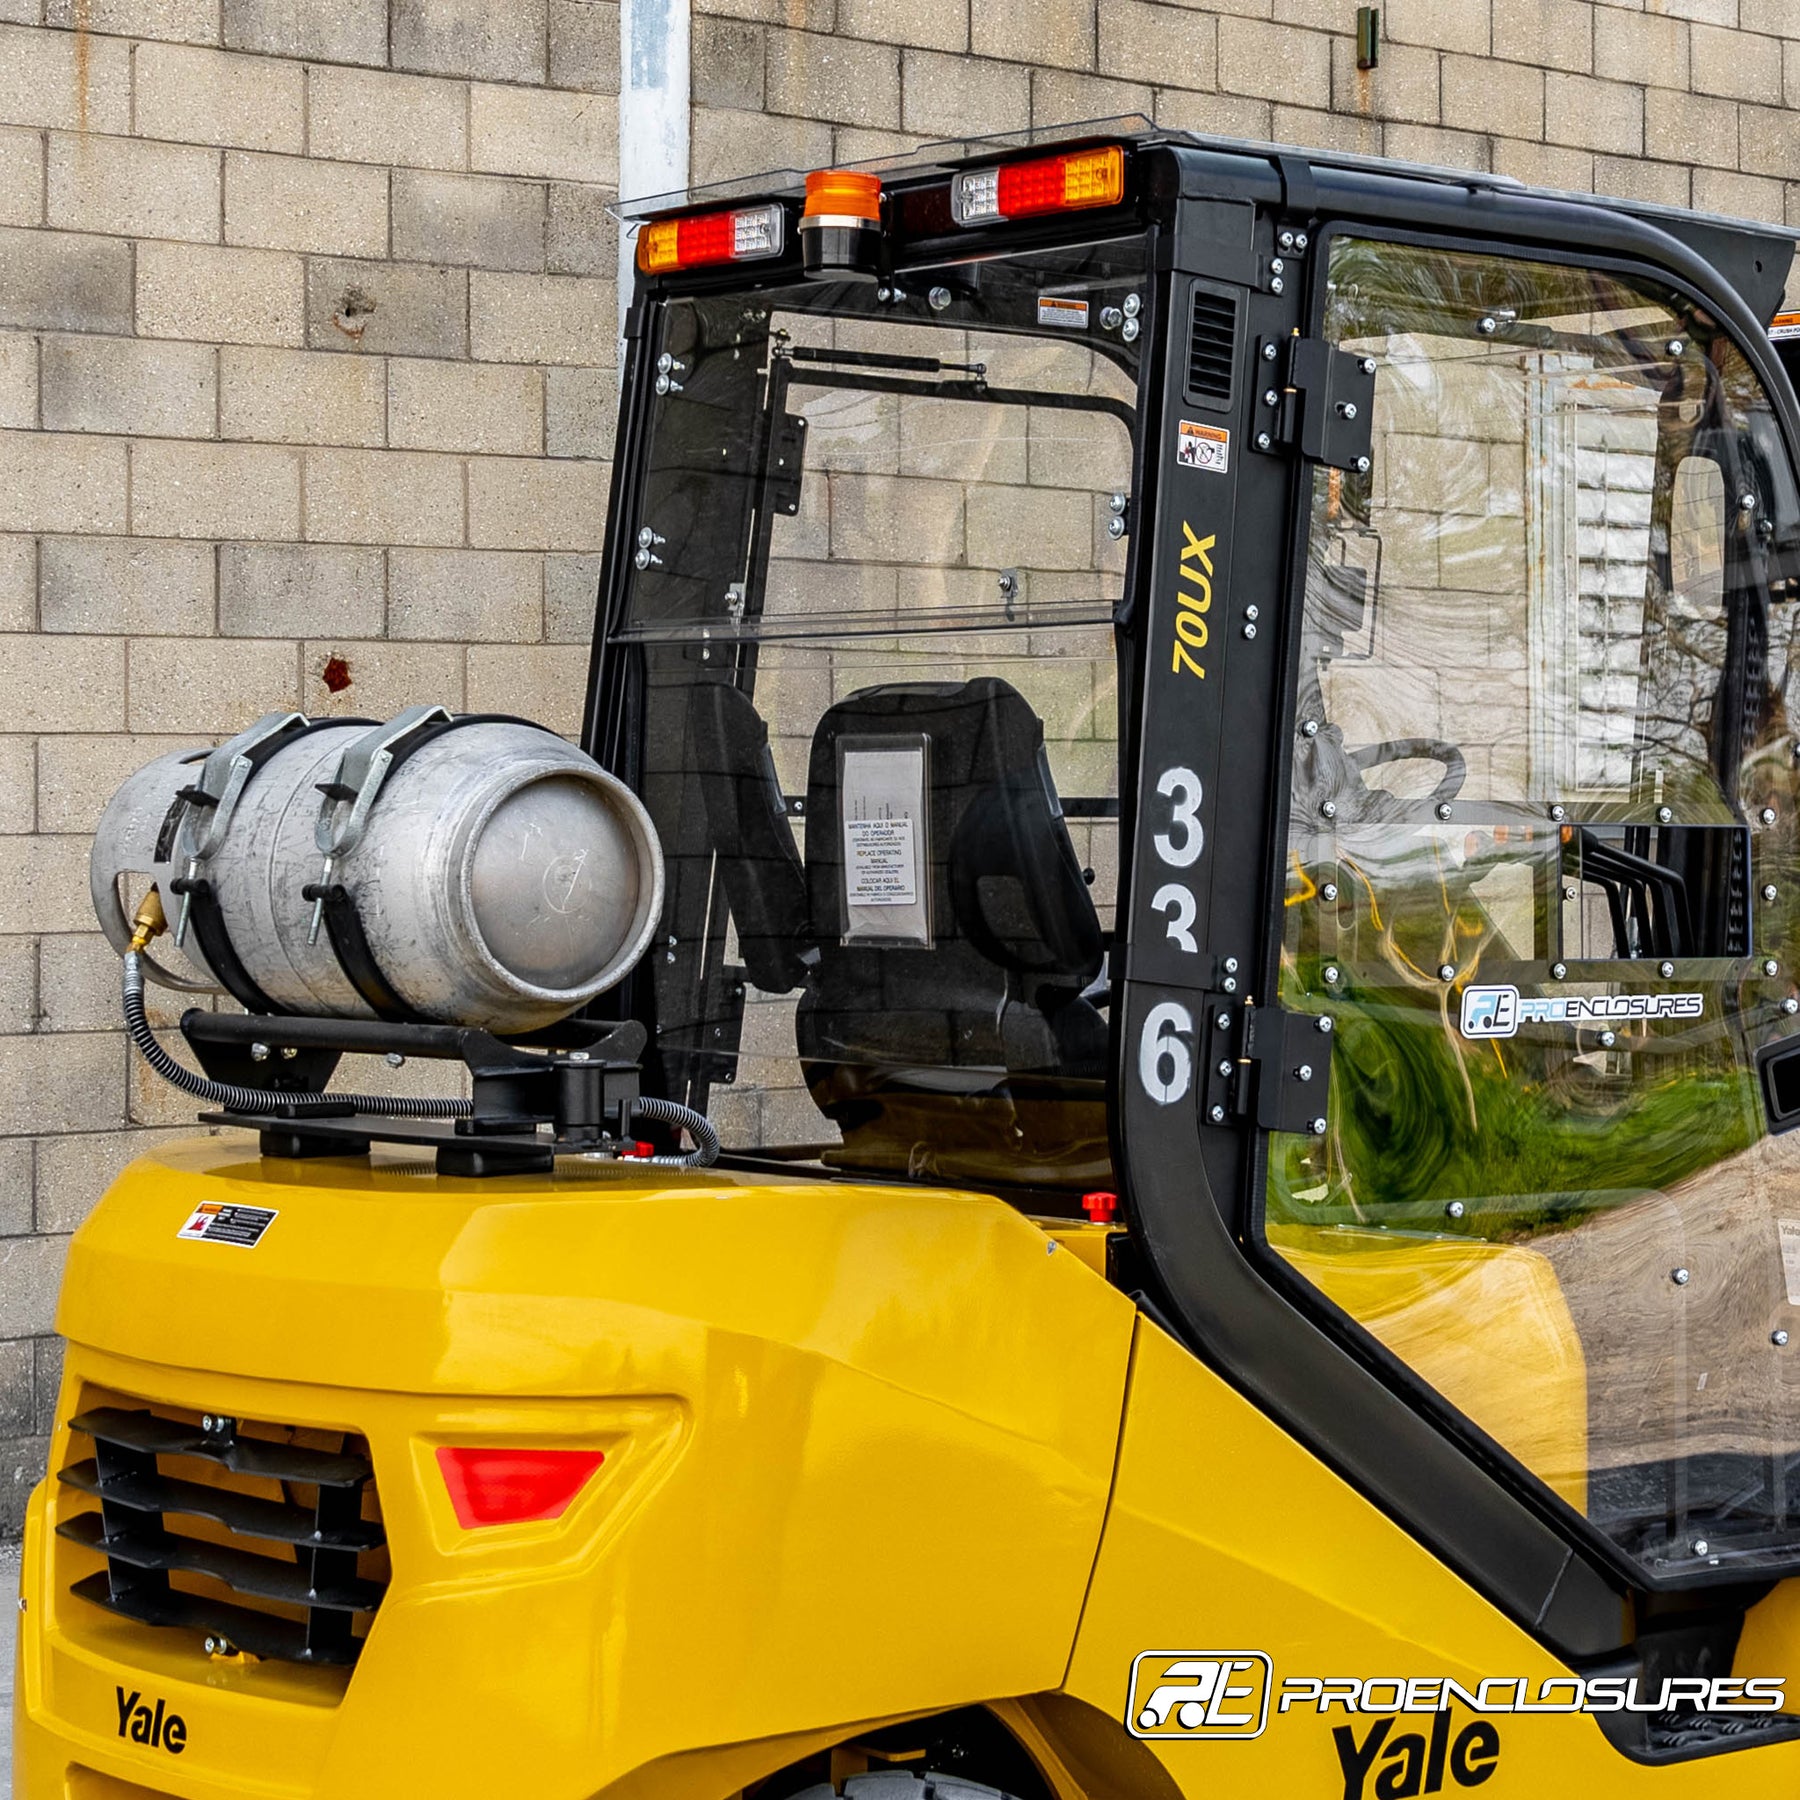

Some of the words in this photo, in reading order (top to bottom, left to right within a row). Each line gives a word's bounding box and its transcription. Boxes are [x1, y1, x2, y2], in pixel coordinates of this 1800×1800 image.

[1172, 520, 1216, 680] 70UX
[1520, 997, 1701, 1020] PROENCLOSURES
[116, 1685, 187, 1754] Yale
[1332, 1706, 1500, 1800] Yale
